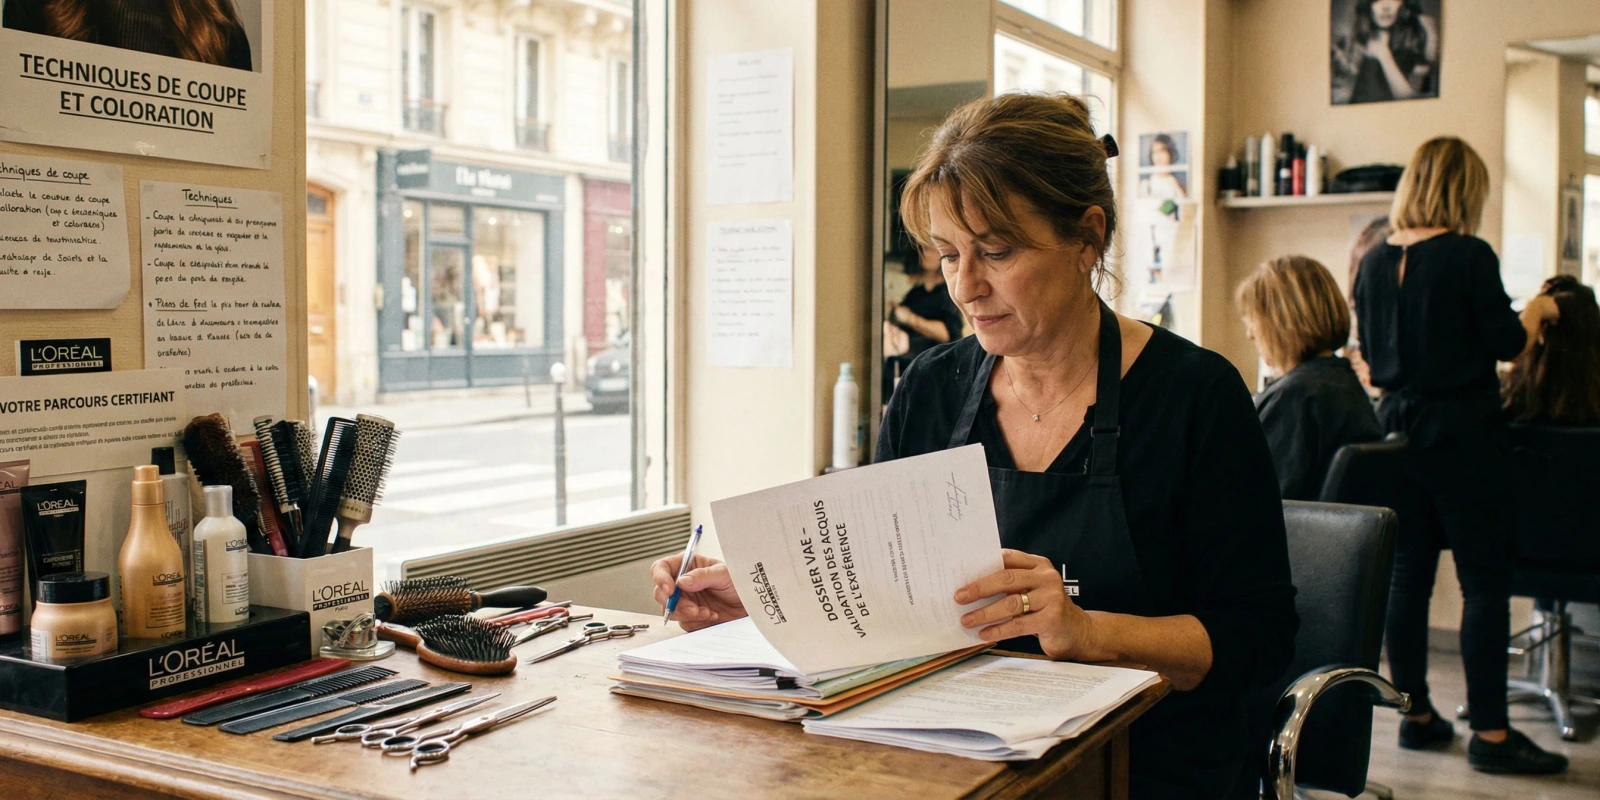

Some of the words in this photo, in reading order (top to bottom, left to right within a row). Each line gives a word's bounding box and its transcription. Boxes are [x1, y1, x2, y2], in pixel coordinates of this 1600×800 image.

[19, 53, 151, 91] TECHNIQUES
[157, 76, 181, 96] DE
[187, 81, 247, 106] COUPE
[60, 91, 84, 112] ET
[90, 95, 214, 129] COLORATION
[47, 167, 58, 178] de
[63, 171, 90, 185] coupe
[29, 191, 37, 199] le
[75, 194, 85, 202] de
[88, 197, 110, 207] coupe
[153, 210, 175, 223] Coupe
[43, 253, 52, 261] de
[99, 254, 108, 262] la
[154, 258, 175, 270] Coupe
[180, 299, 190, 308] de
[31, 345, 103, 362] L'ORÉAL
[32, 361, 103, 370] PROFESSIONNEL
[0, 400, 41, 414] VOTRE
[45, 395, 108, 411] PARCOURS
[111, 391, 175, 406] CERTIFIANT
[814, 500, 832, 544] ACQUIS
[801, 537, 816, 565] VAE
[823, 547, 837, 569] DES
[836, 522, 863, 600] L'EXPÉRIENCE
[312, 580, 369, 602] L'ORÉAL
[750, 564, 781, 625] L'ORÉAL
[809, 566, 838, 621] DOSSIER
[829, 571, 867, 638] VALIDATION
[856, 601, 870, 617] DE
[149, 639, 245, 677] L'ORÉAL
[151, 658, 244, 689] PROFESSIONNEL
